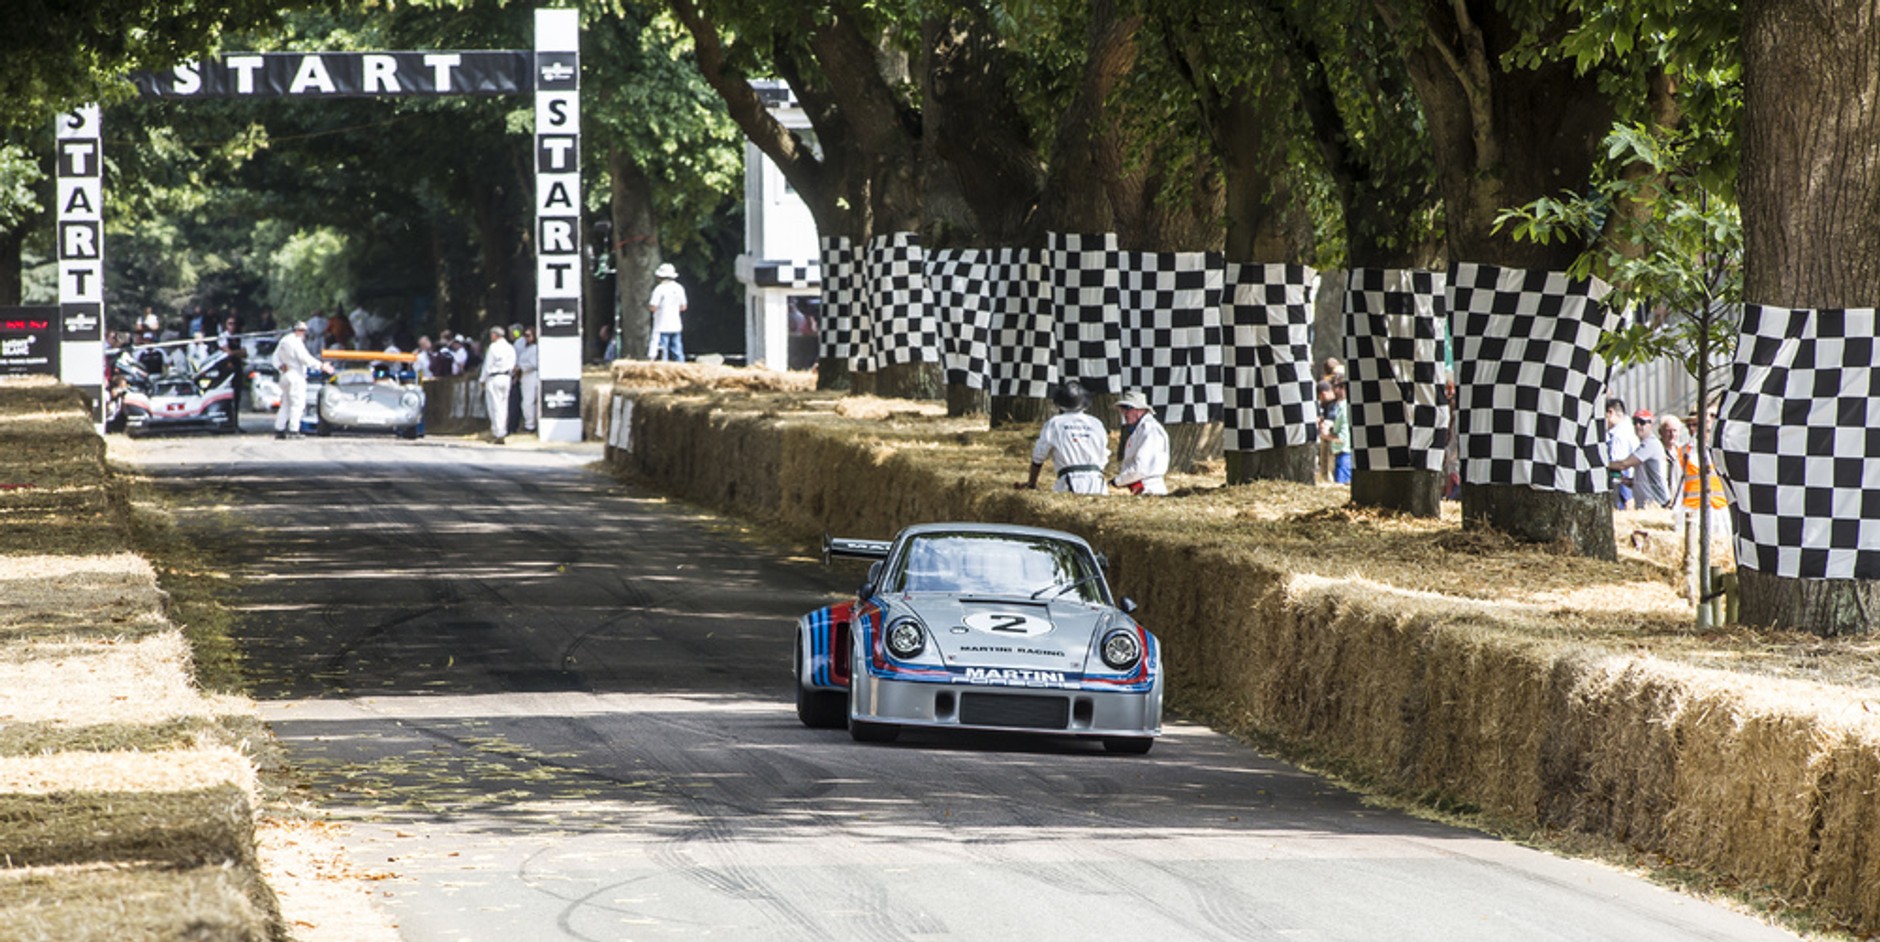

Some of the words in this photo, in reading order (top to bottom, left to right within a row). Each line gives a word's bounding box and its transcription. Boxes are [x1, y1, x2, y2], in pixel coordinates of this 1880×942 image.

[173, 55, 461, 95] START
[64, 108, 97, 296] START
[543, 98, 575, 290] START
[990, 614, 1028, 634] 2
[1017, 648, 1066, 657] RACING
[965, 667, 1066, 682] MARTINI
